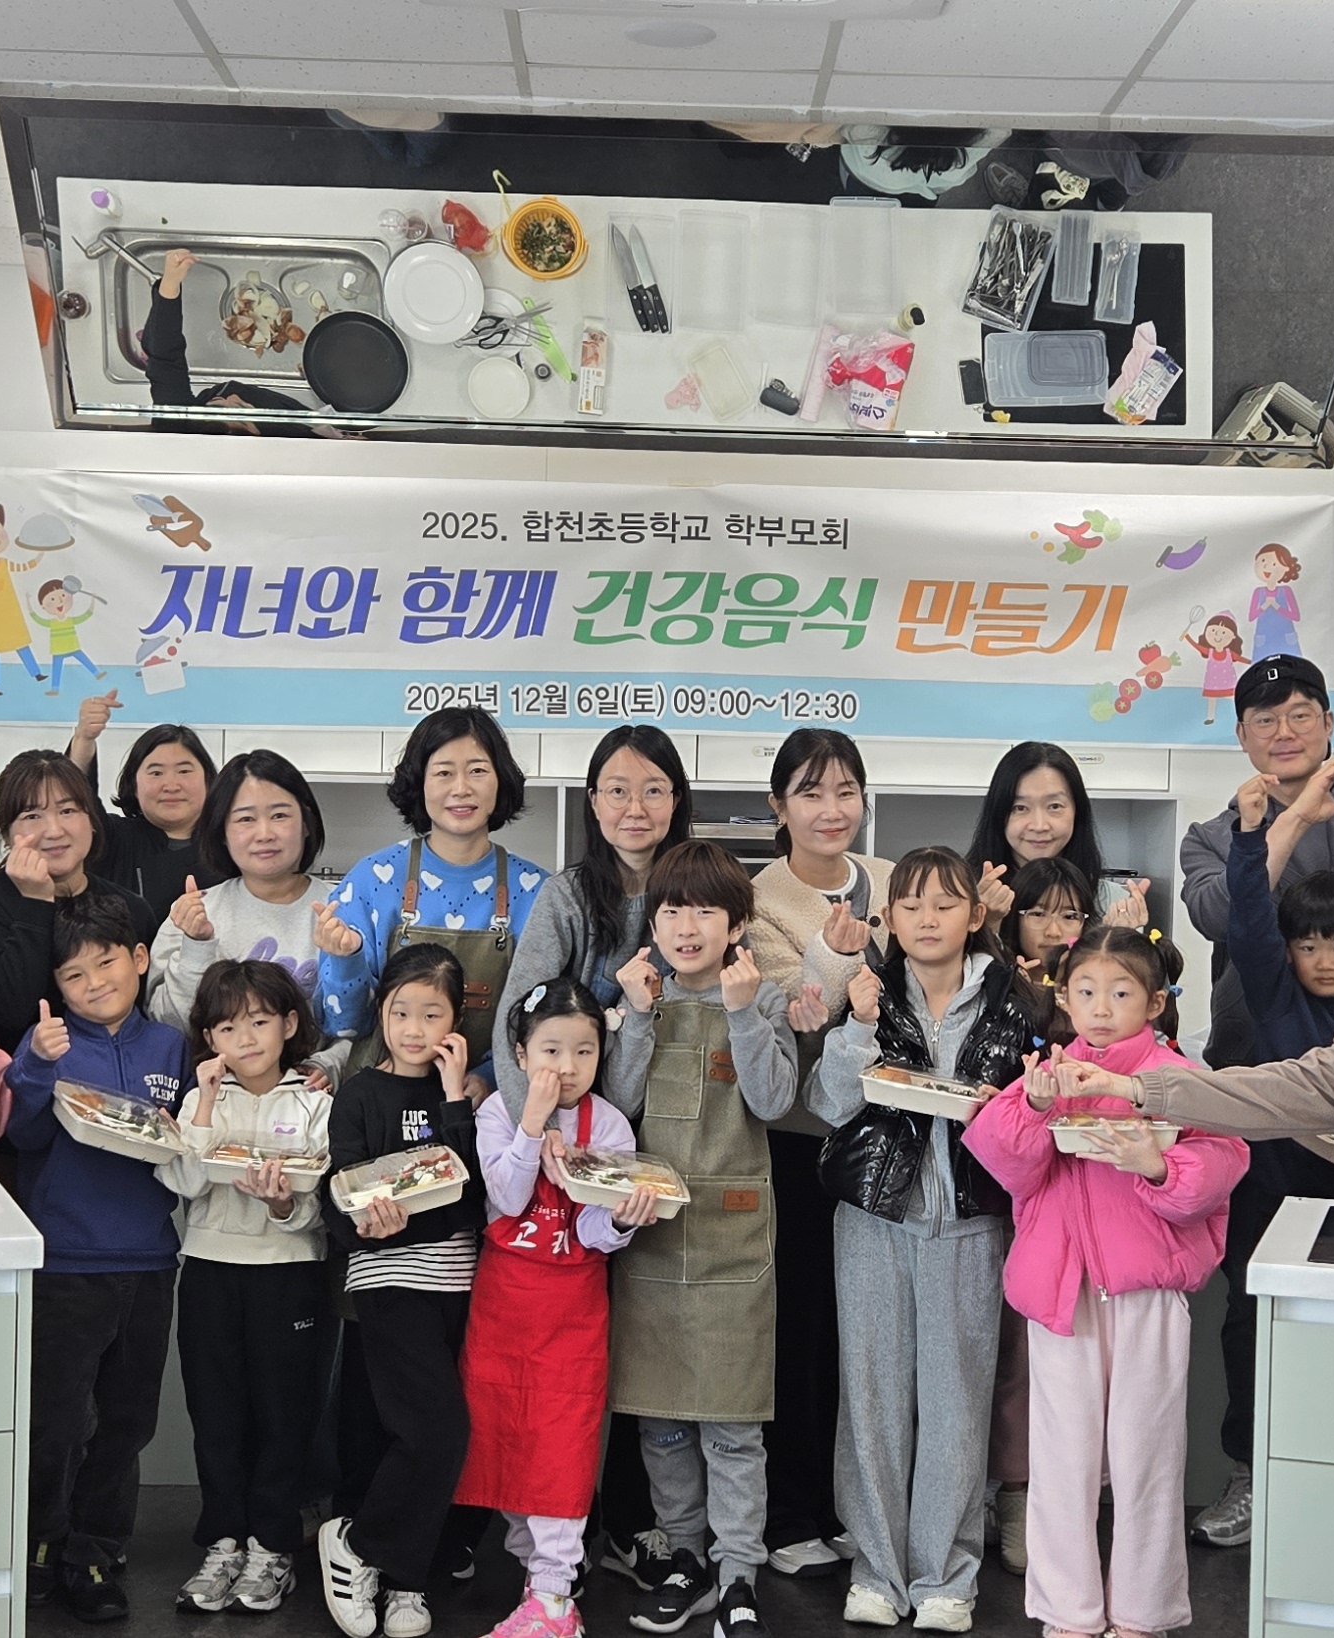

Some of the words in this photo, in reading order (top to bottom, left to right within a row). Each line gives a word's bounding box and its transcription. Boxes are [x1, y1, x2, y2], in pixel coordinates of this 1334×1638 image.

[422, 511, 508, 542] 2025.
[522, 510, 711, 544] 합천초등학교
[724, 513, 849, 550] 학부모회
[138, 564, 381, 640] 자녀와
[399, 566, 558, 644] 함께
[573, 570, 878, 650] 건강음식
[896, 579, 1128, 655] 만들기
[407, 684, 498, 713] 2025년
[511, 684, 567, 715] 12월
[577, 684, 665, 717] 6일(토)
[402, 1109, 429, 1126] LUC
[402, 1125, 419, 1142] KY
